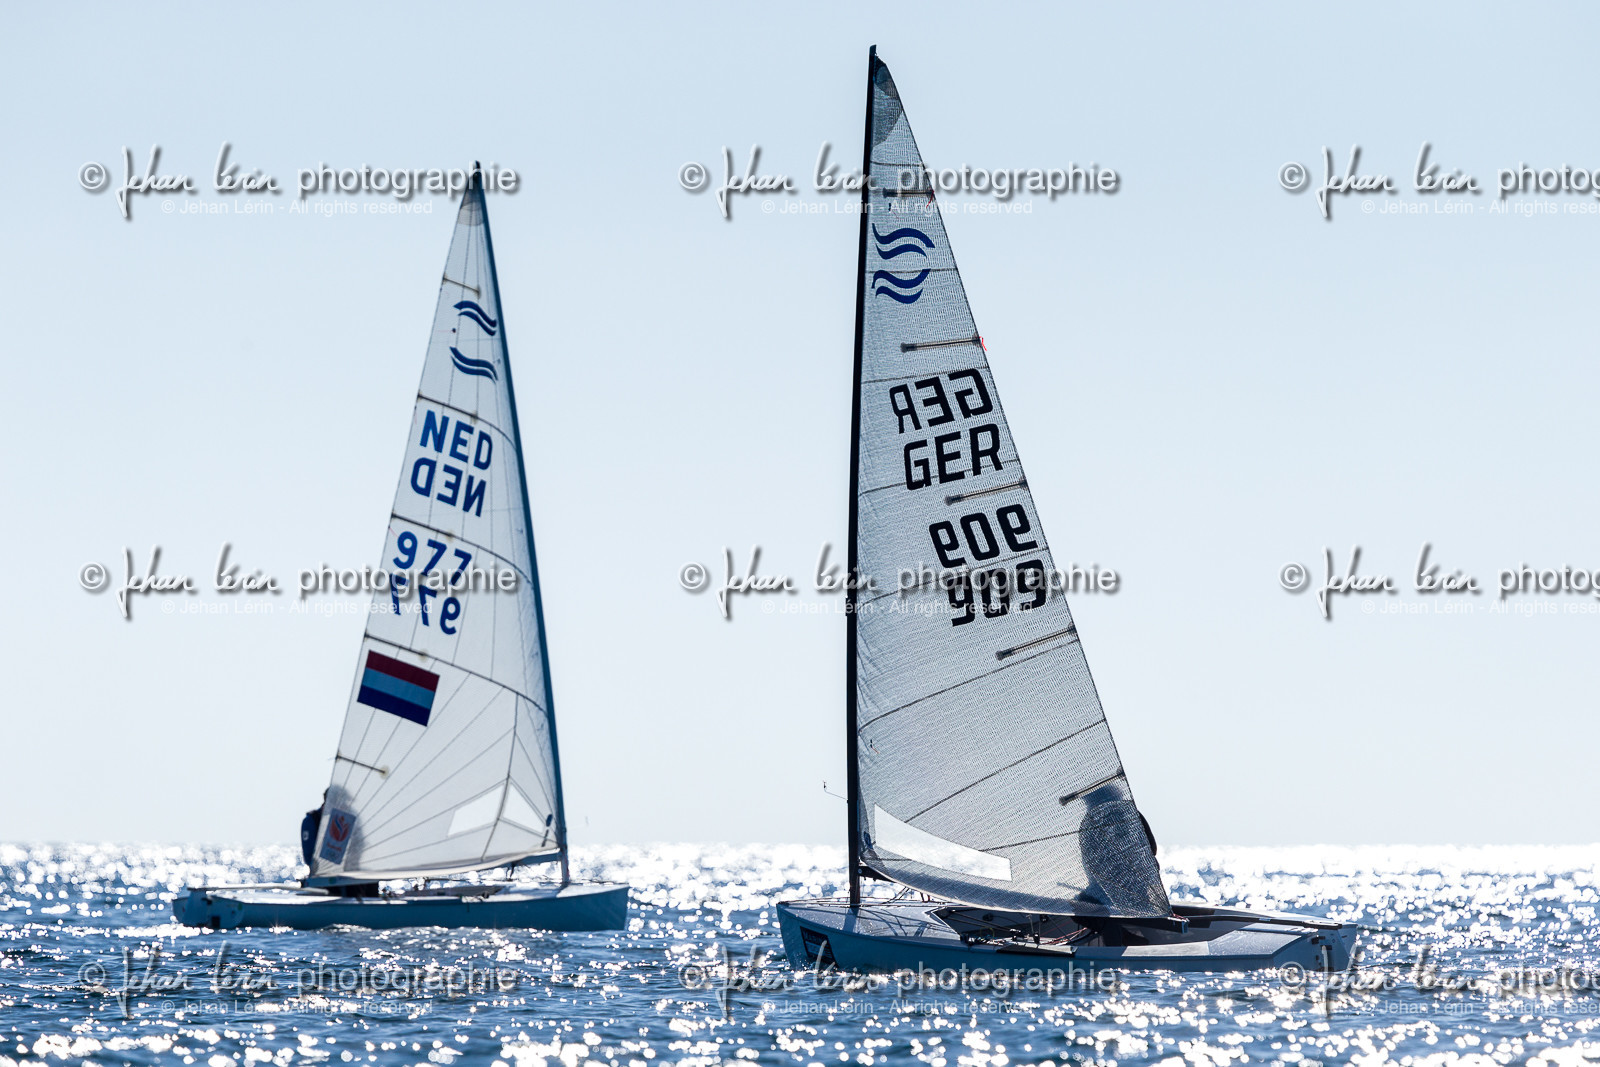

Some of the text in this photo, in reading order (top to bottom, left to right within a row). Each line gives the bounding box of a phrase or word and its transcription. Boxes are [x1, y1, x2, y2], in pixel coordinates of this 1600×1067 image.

[419, 409, 493, 471] NED
[903, 423, 1004, 491] GER
[392, 530, 473, 587] 977
[946, 559, 1047, 628] 909
